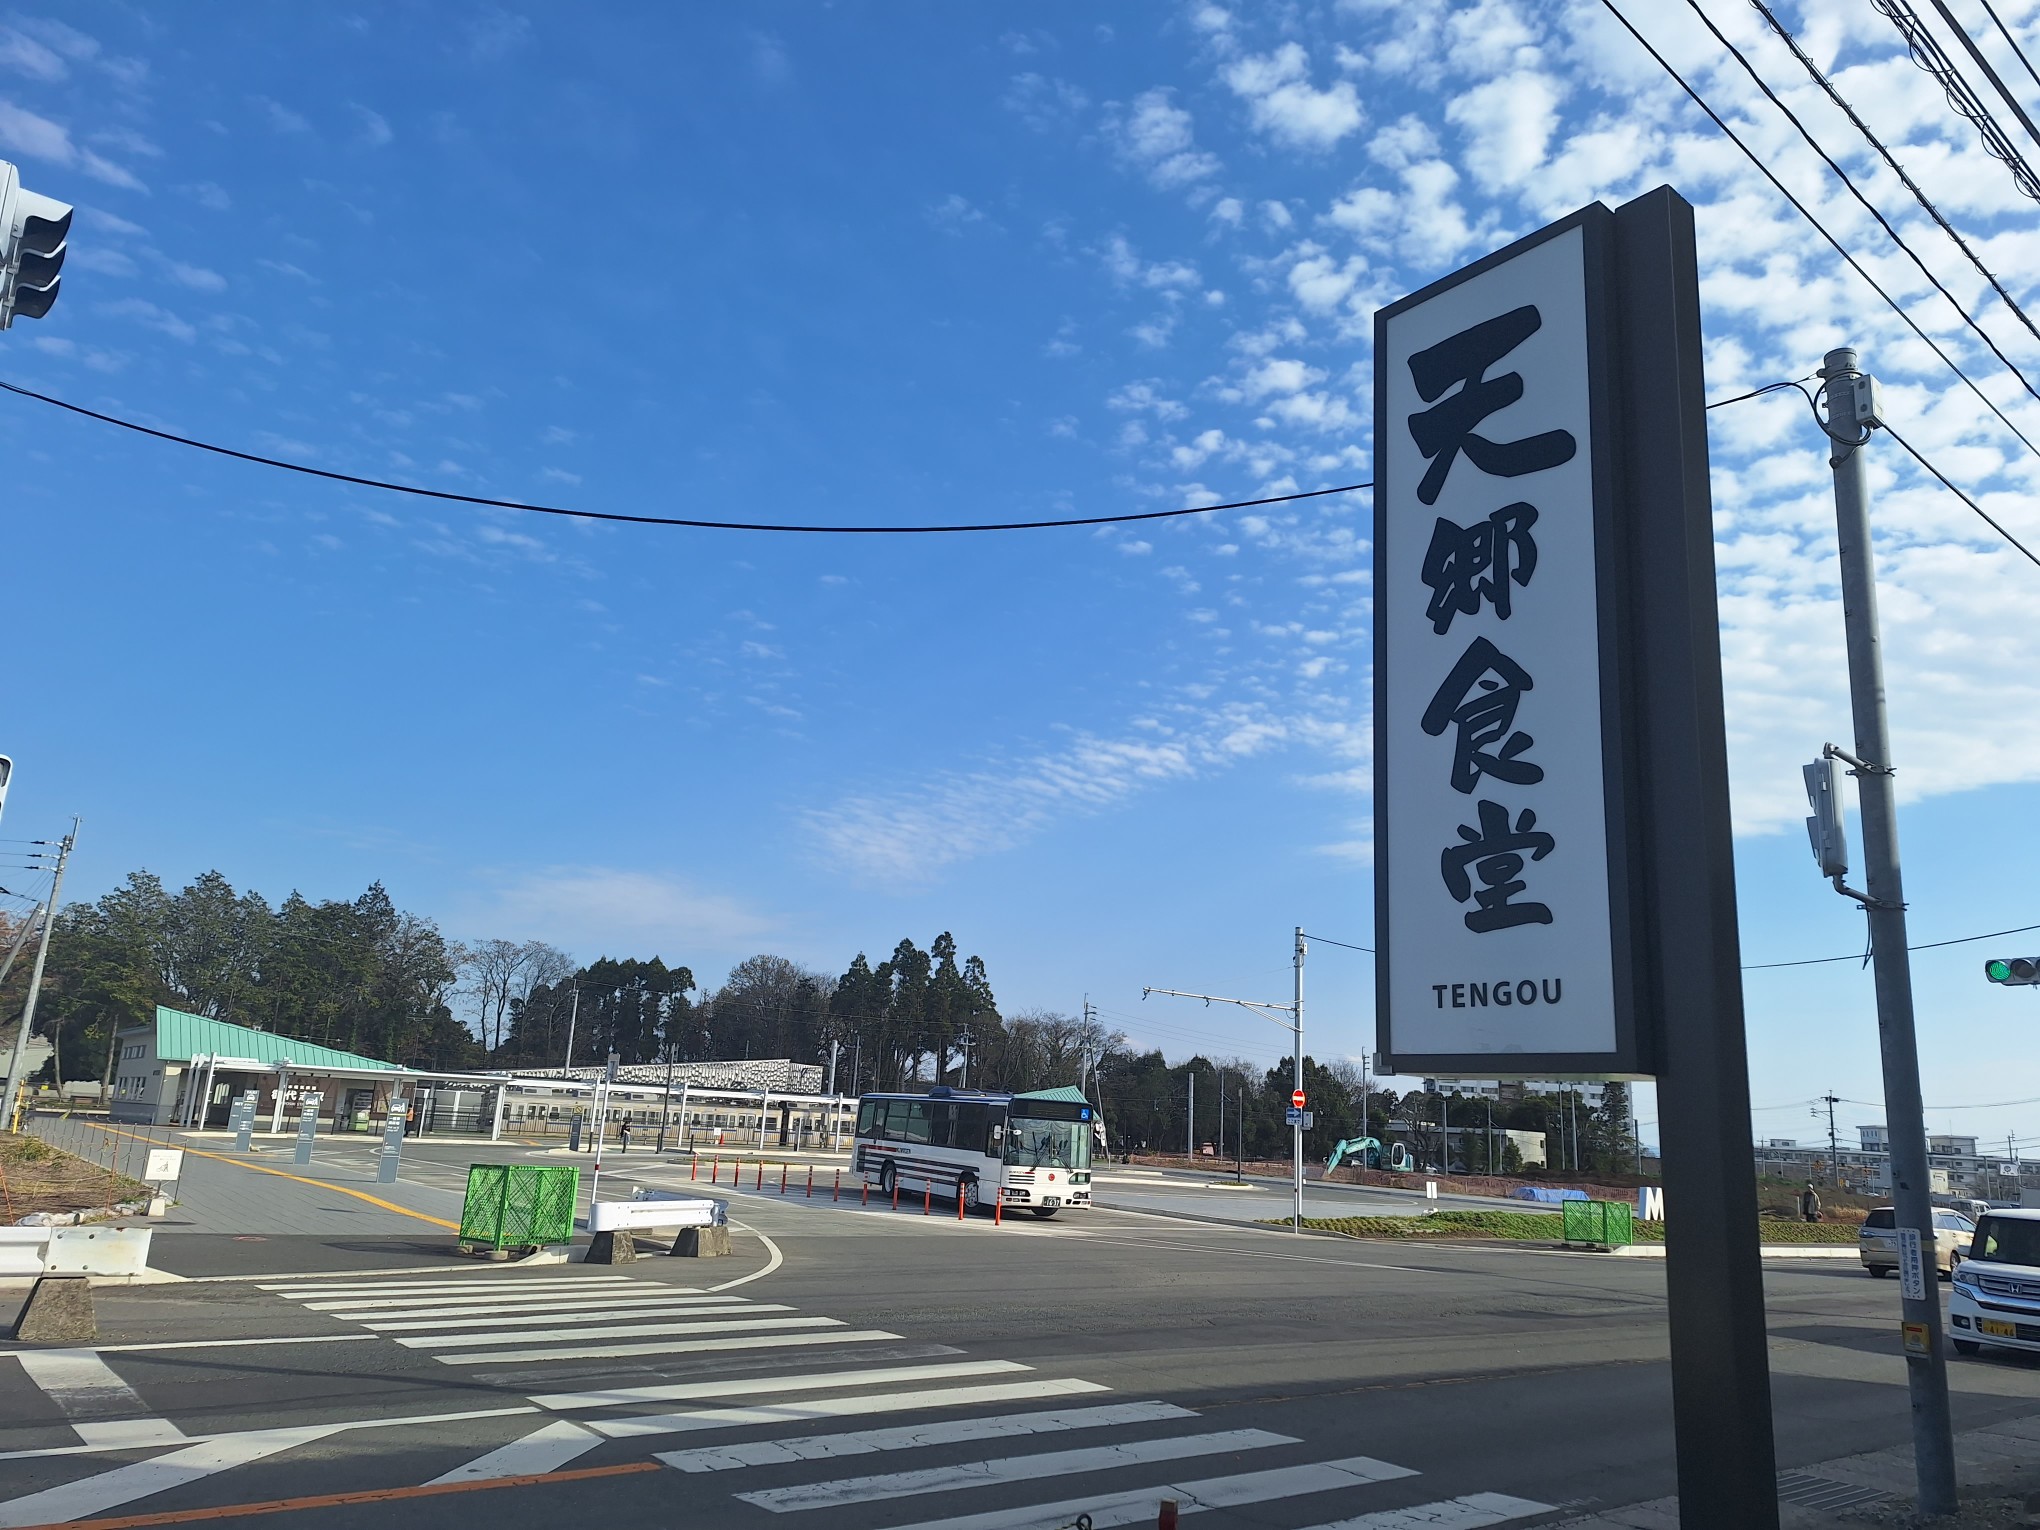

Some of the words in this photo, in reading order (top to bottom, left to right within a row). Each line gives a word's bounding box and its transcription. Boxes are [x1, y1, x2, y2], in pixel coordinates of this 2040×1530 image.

[1407, 305, 1576, 934] 天郷食堂
[1432, 977, 1561, 1008] TENGOU
